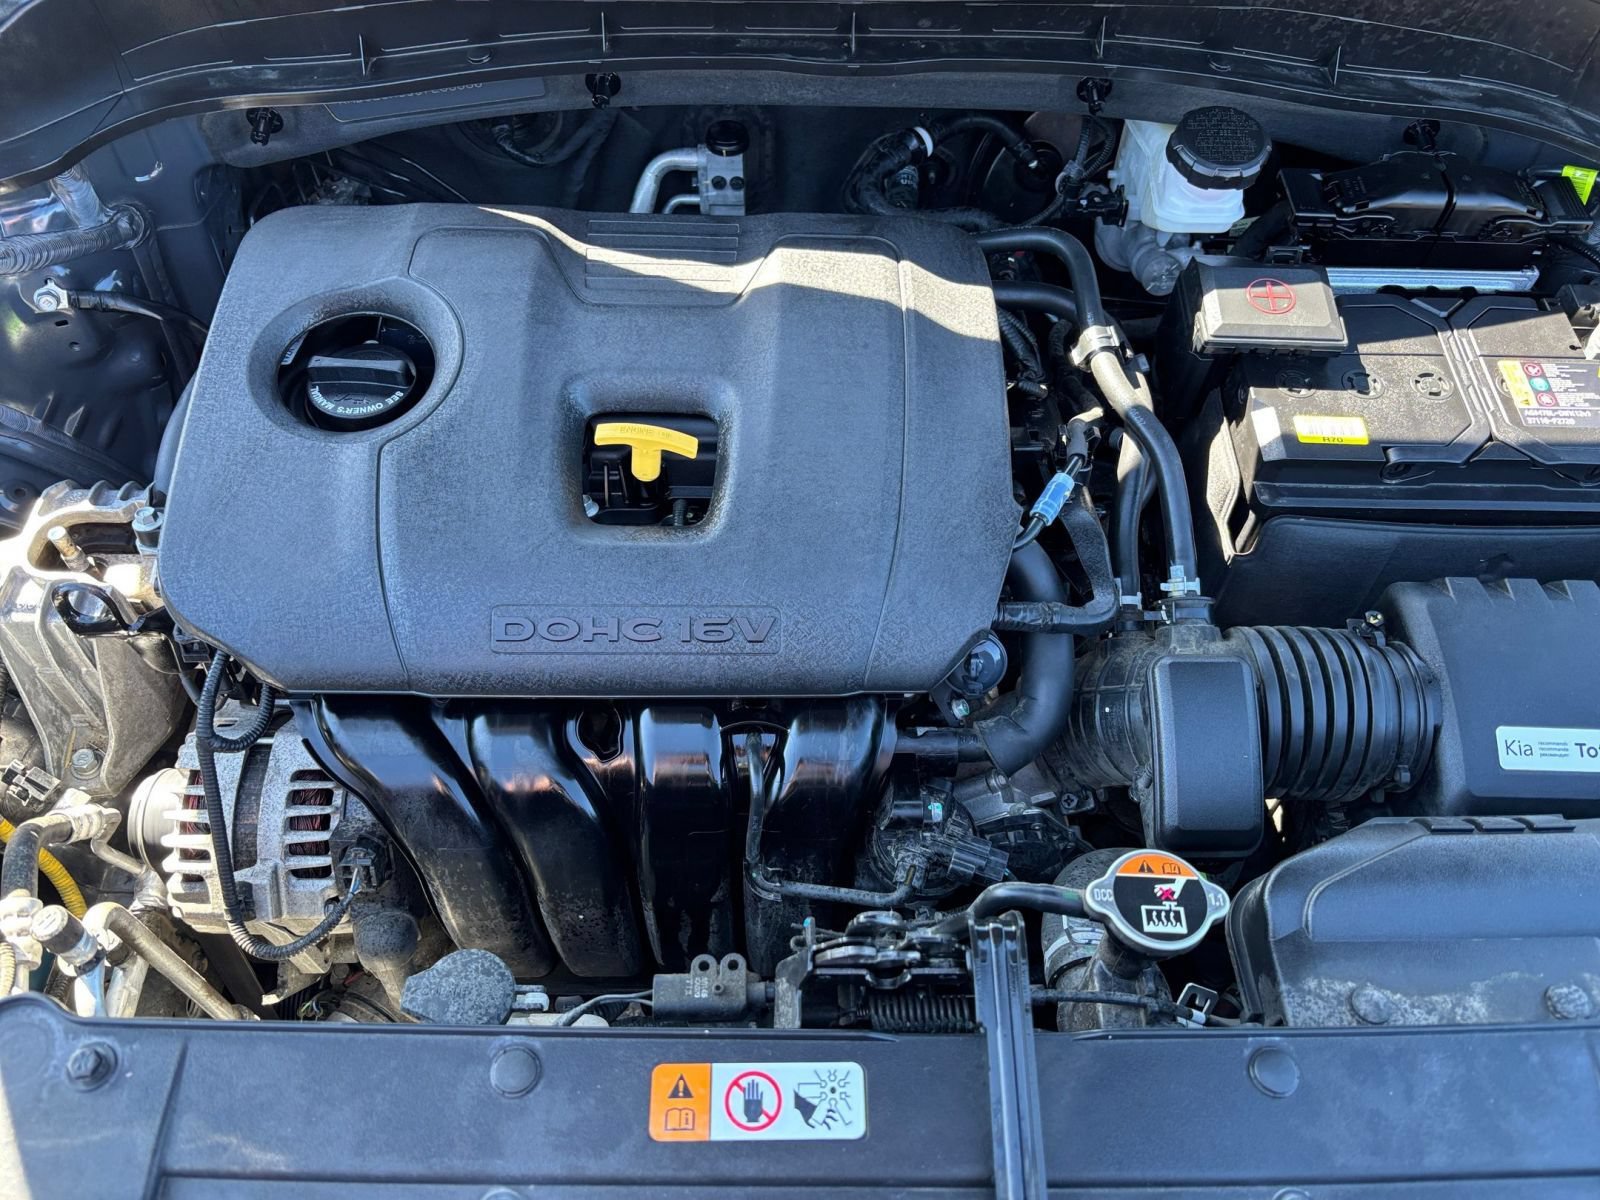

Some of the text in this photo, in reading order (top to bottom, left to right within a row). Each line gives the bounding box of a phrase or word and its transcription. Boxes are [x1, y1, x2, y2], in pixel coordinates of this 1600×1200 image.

[309, 385, 404, 414] SEE OWNER'S MANUAL
[495, 615, 777, 644] DOHC 16V
[1504, 739, 1600, 759] Kia To
[1208, 893, 1224, 906] 1.1
